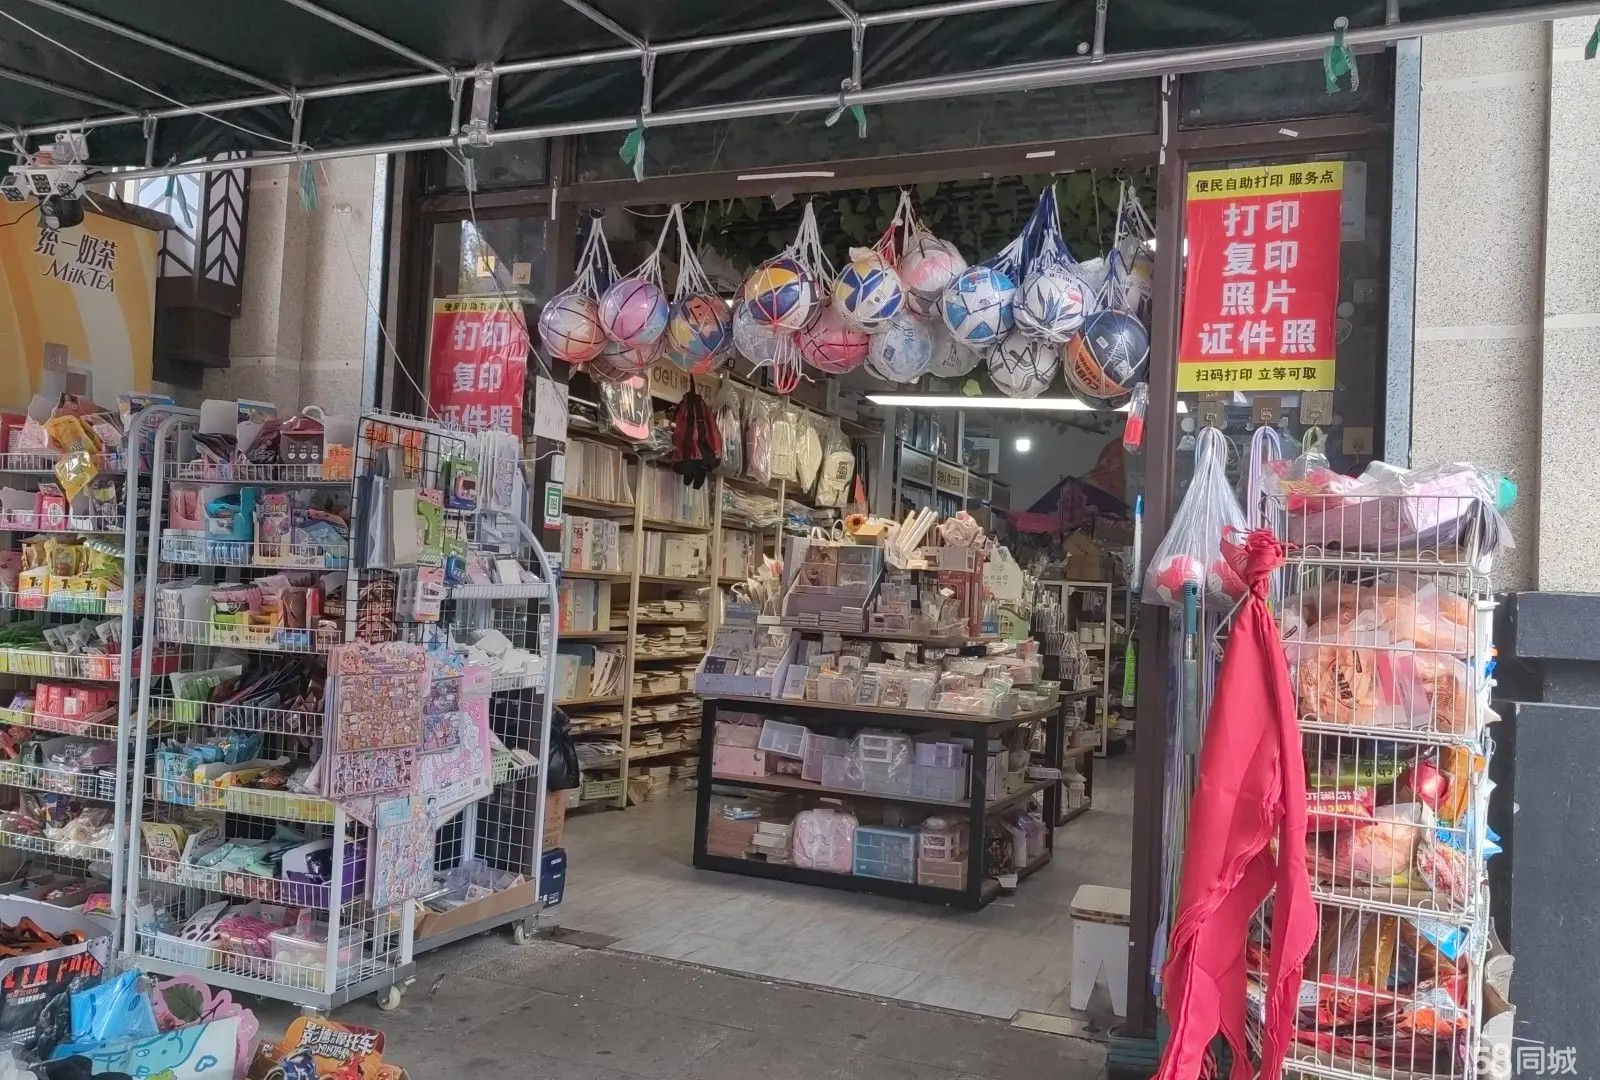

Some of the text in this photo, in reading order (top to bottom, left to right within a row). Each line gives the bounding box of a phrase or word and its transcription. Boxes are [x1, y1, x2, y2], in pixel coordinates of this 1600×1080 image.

[1196, 170, 1334, 193] 便民自助打印 服务点
[1223, 200, 1300, 237] 打印
[1222, 240, 1298, 276] 复印
[1219, 279, 1297, 316] 照片
[454, 320, 510, 351] 打印
[1198, 319, 1316, 355] 证件照
[452, 361, 502, 393] 复印
[653, 366, 678, 390] deli
[1196, 366, 1317, 382] 扫码打印 立等可取
[438, 404, 513, 435] 证件照
